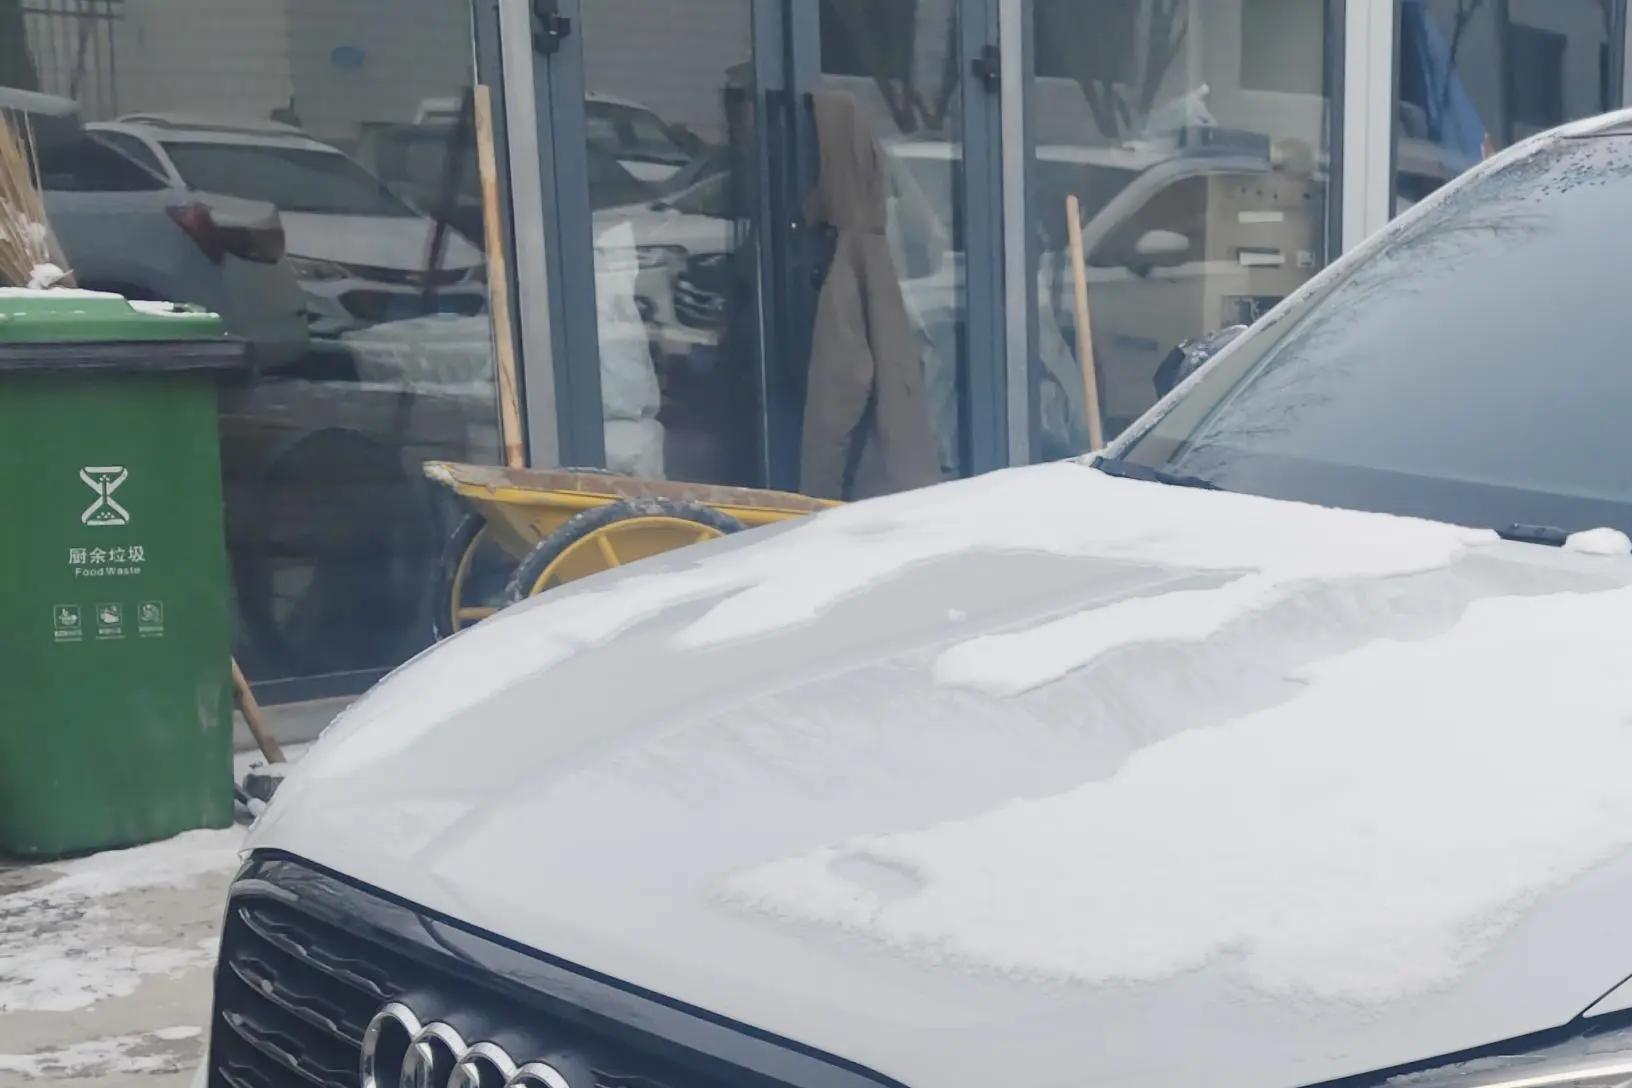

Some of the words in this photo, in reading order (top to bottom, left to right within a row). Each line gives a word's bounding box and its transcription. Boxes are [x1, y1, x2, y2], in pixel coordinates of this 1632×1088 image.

[69, 545, 146, 564] 厨余垃圾
[75, 567, 104, 577] Food
[105, 565, 142, 576] Waste
